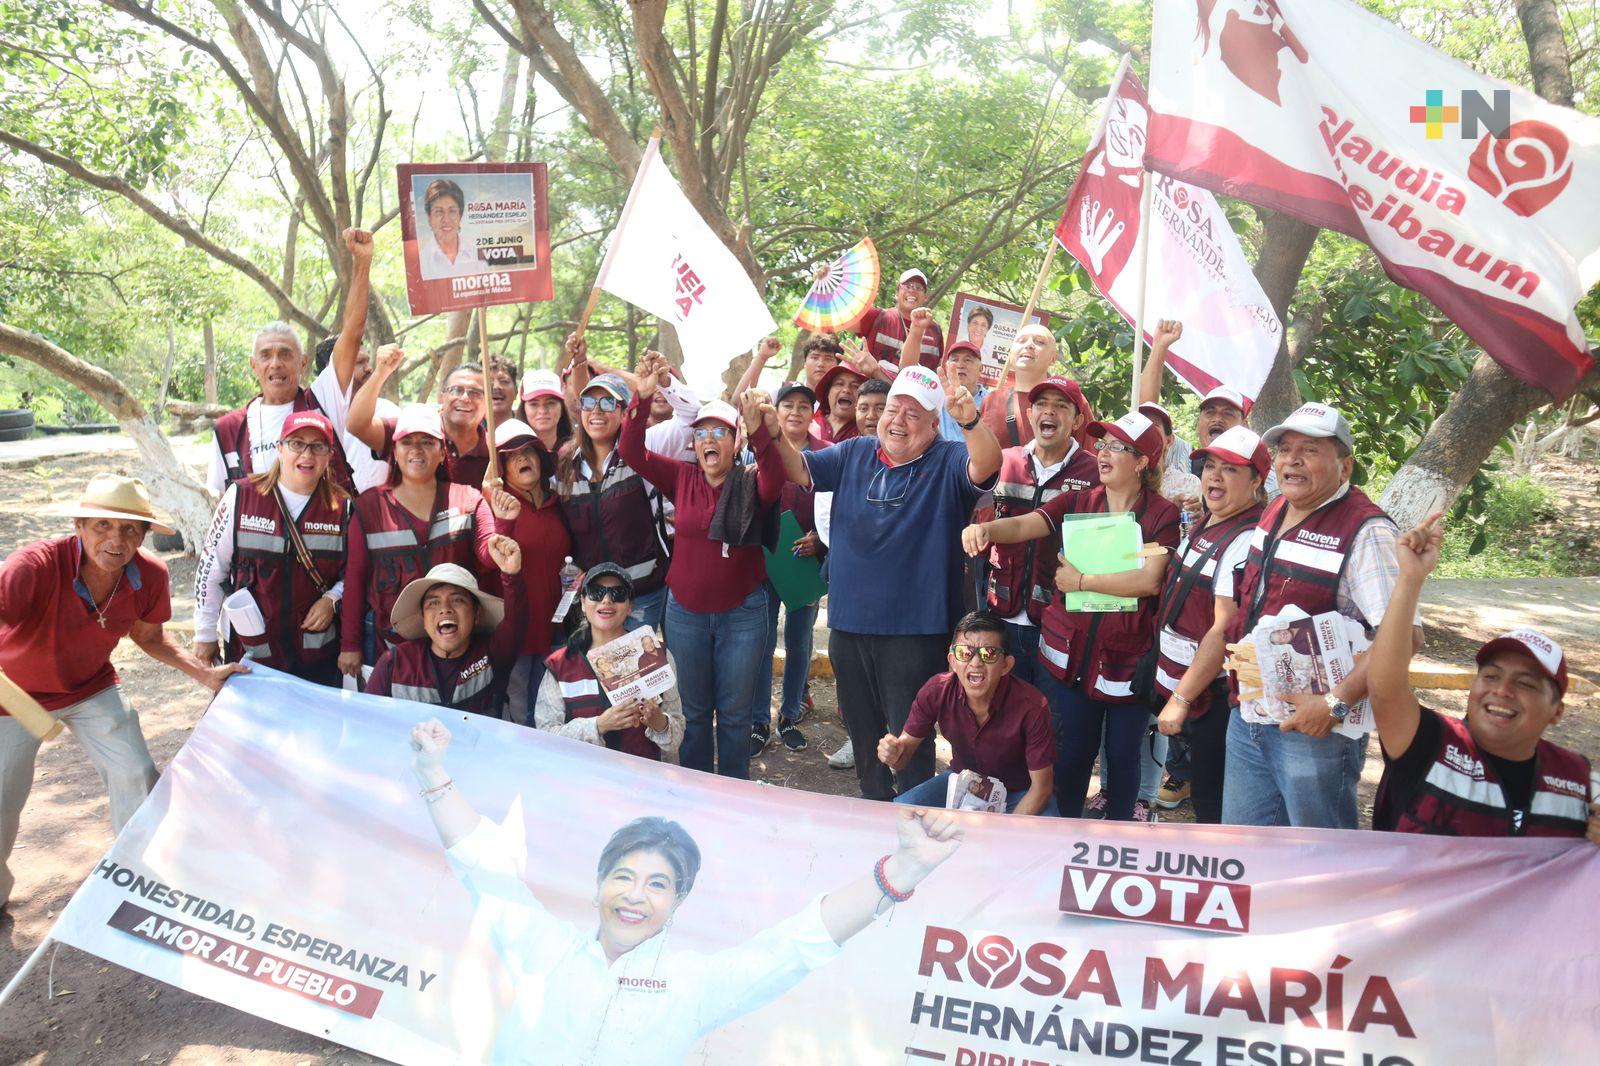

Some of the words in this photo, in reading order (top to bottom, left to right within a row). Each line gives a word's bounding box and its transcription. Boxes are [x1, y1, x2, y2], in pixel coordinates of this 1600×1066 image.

[467, 202, 493, 212] ROSA
[495, 200, 527, 211] MARÍA
[476, 238, 482, 246] 2
[482, 237, 494, 245] DE
[496, 235, 523, 244] JUNIO
[1153, 193, 1227, 279] HERNÁNDE
[483, 247, 517, 259] VOTA
[452, 273, 511, 291] morena
[1064, 478, 1091, 486] morena
[304, 521, 340, 532] morena
[1298, 529, 1340, 546] morena
[1319, 621, 1330, 651] MANUEL
[1324, 619, 1335, 650] HUERTA
[644, 670, 668, 683] MANUEL
[1329, 659, 1341, 685] AUDIA
[612, 684, 640, 699] CLAUDIA
[1543, 775, 1586, 796] morena
[1071, 841, 1090, 865] 2
[1097, 844, 1139, 870] DE
[1146, 850, 1245, 881] JUNIO
[1068, 868, 1244, 929] VOTA
[94, 858, 257, 941] HONESTIDAD,
[261, 922, 409, 988] ESPERANZA
[418, 970, 437, 992] Y
[133, 915, 217, 960] AMOR
[214, 944, 250, 973] AL
[253, 956, 357, 1006] PUEBLO
[617, 976, 667, 989] morena
[918, 925, 1122, 1008] ROSA
[1141, 954, 1417, 1039] MARÍA
[910, 991, 1204, 1066] HERNÁNDEZ
